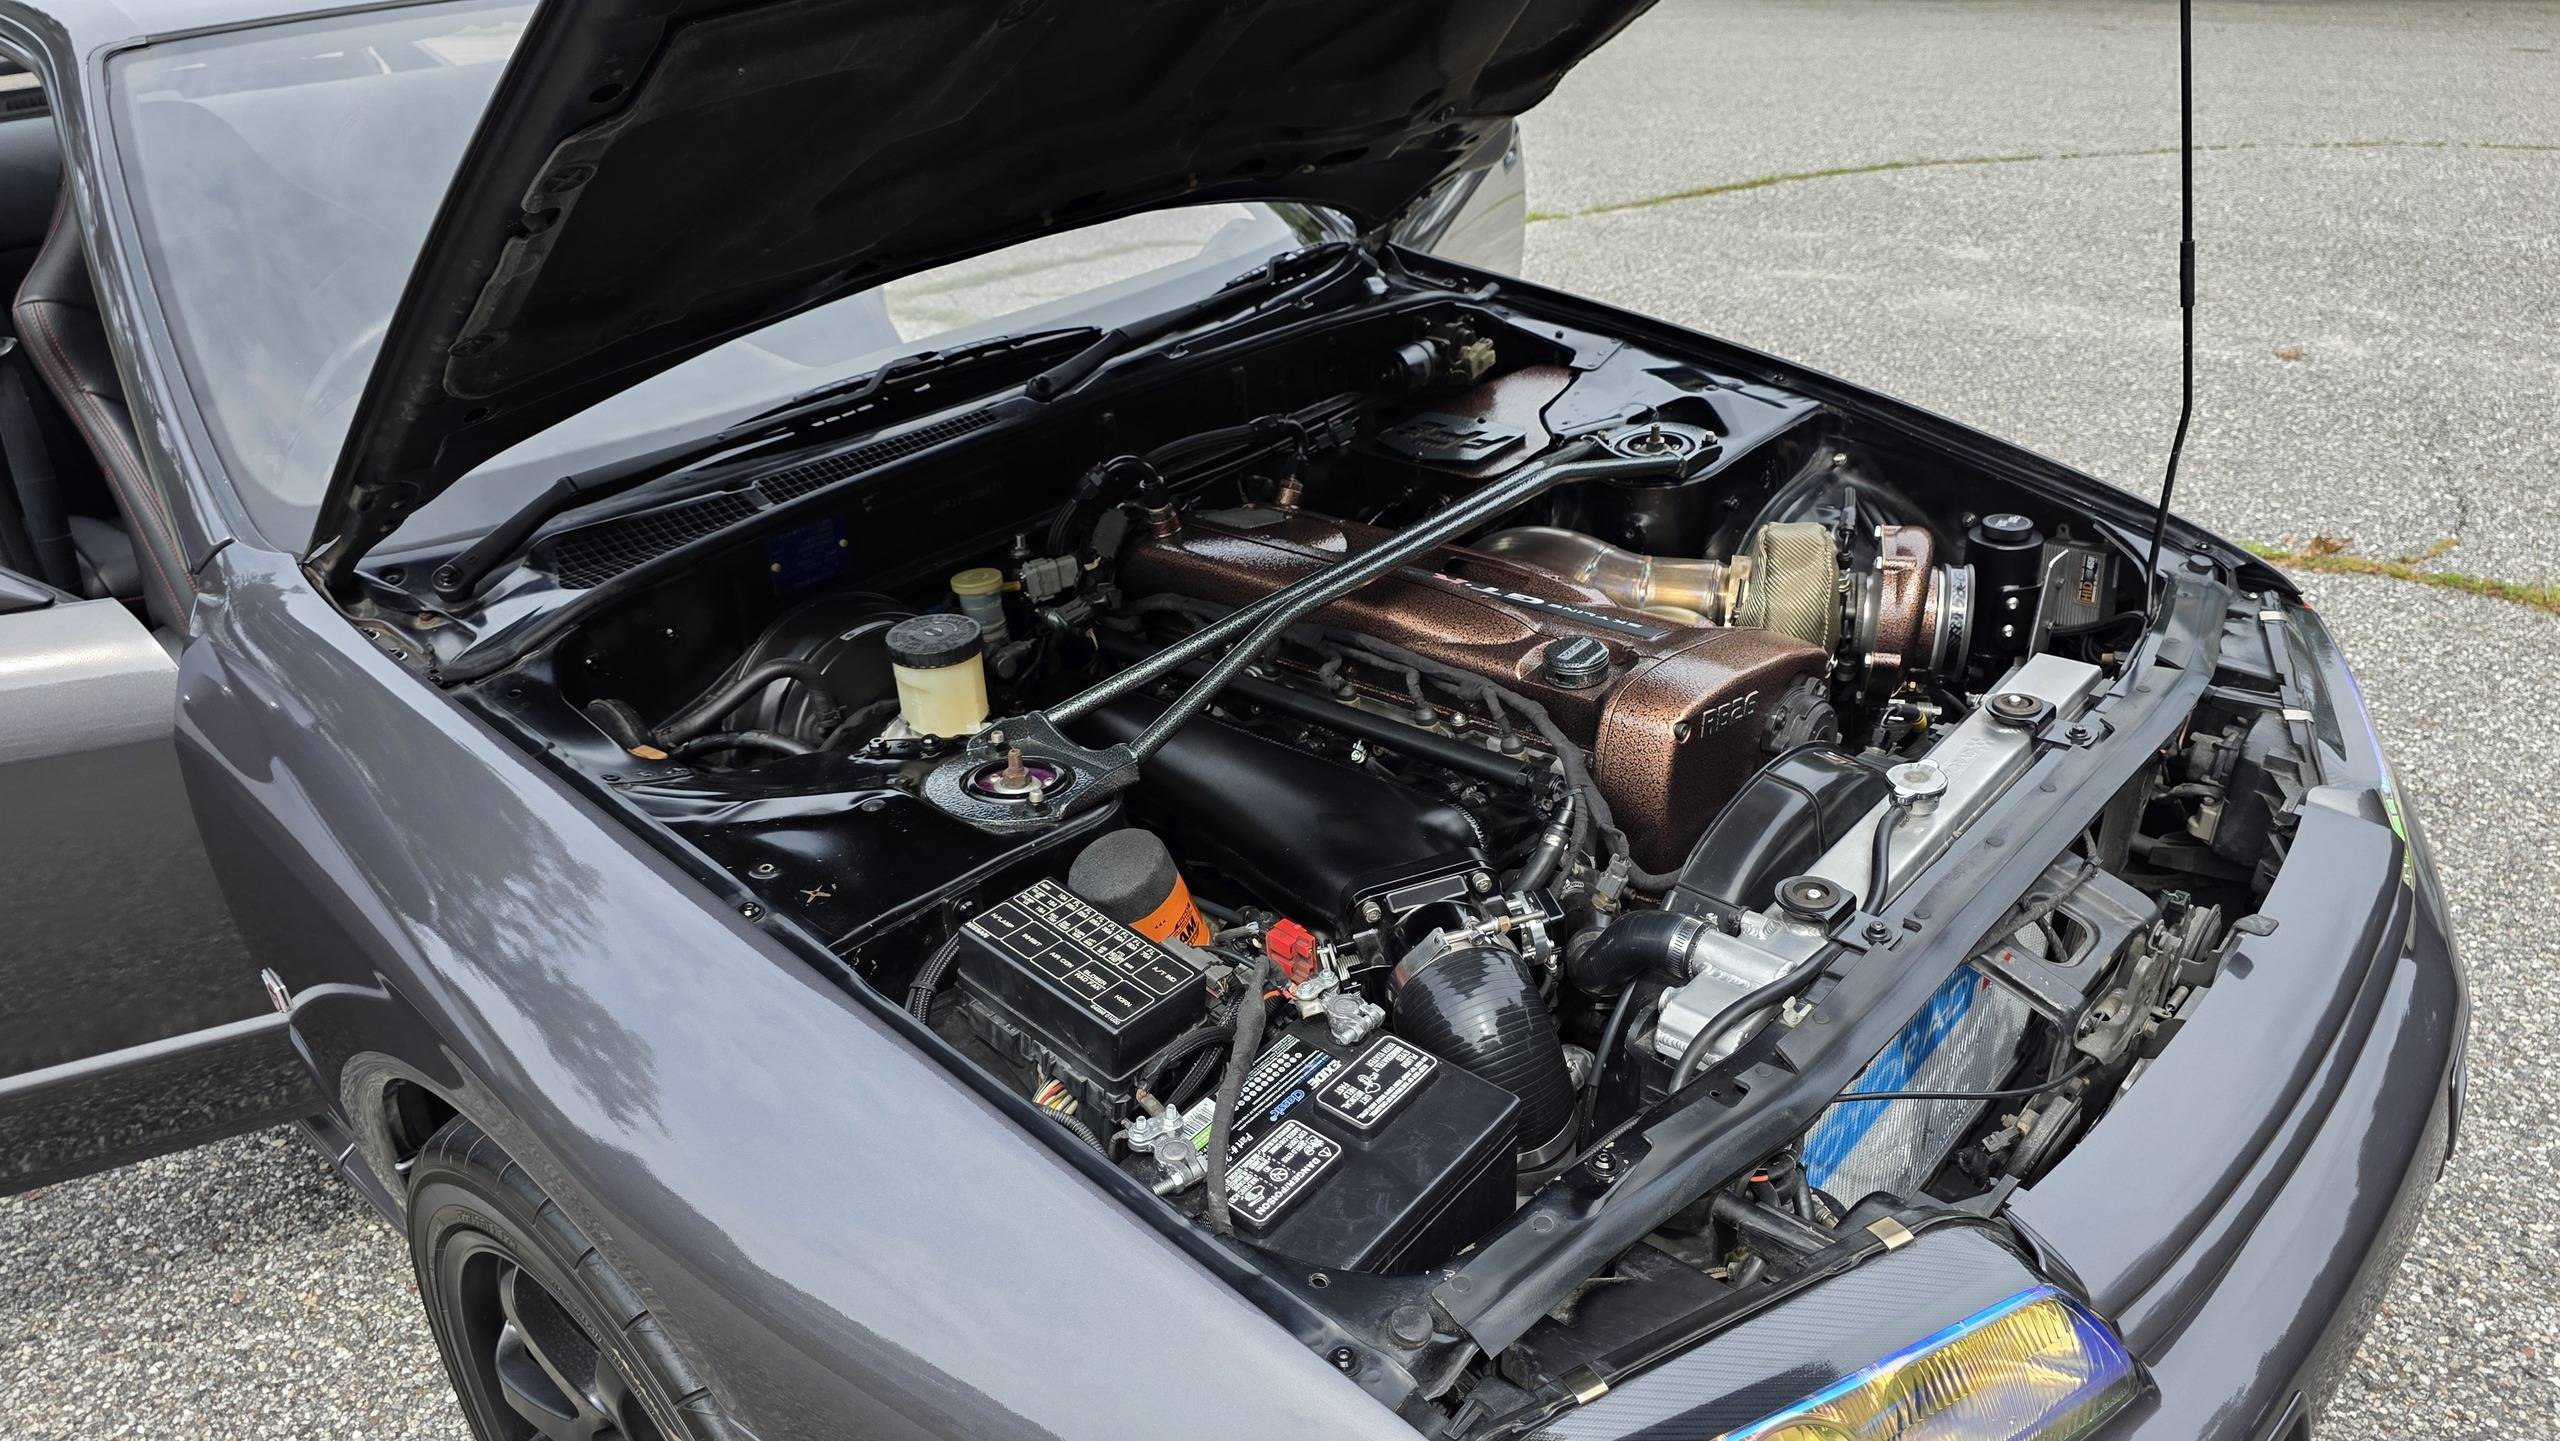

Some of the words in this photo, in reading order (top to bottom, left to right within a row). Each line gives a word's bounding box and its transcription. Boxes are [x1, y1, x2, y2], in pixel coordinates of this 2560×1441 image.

[2080, 581, 2093, 601] HID
[1548, 603, 1643, 629] SKYLINE
[965, 921, 990, 938] NISSAN
[1049, 952, 1061, 960] AIR
[1060, 958, 1074, 968] CON
[1083, 969, 1107, 986] BLOWER
[1087, 980, 1101, 991] FAN
[1114, 994, 1132, 1007] HORN
[1307, 1059, 1342, 1090] EXIDE
[1270, 1089, 1305, 1119] Classic
[1235, 1132, 1254, 1149] Part
[1255, 1157, 1321, 1215] DANGER/POISON
